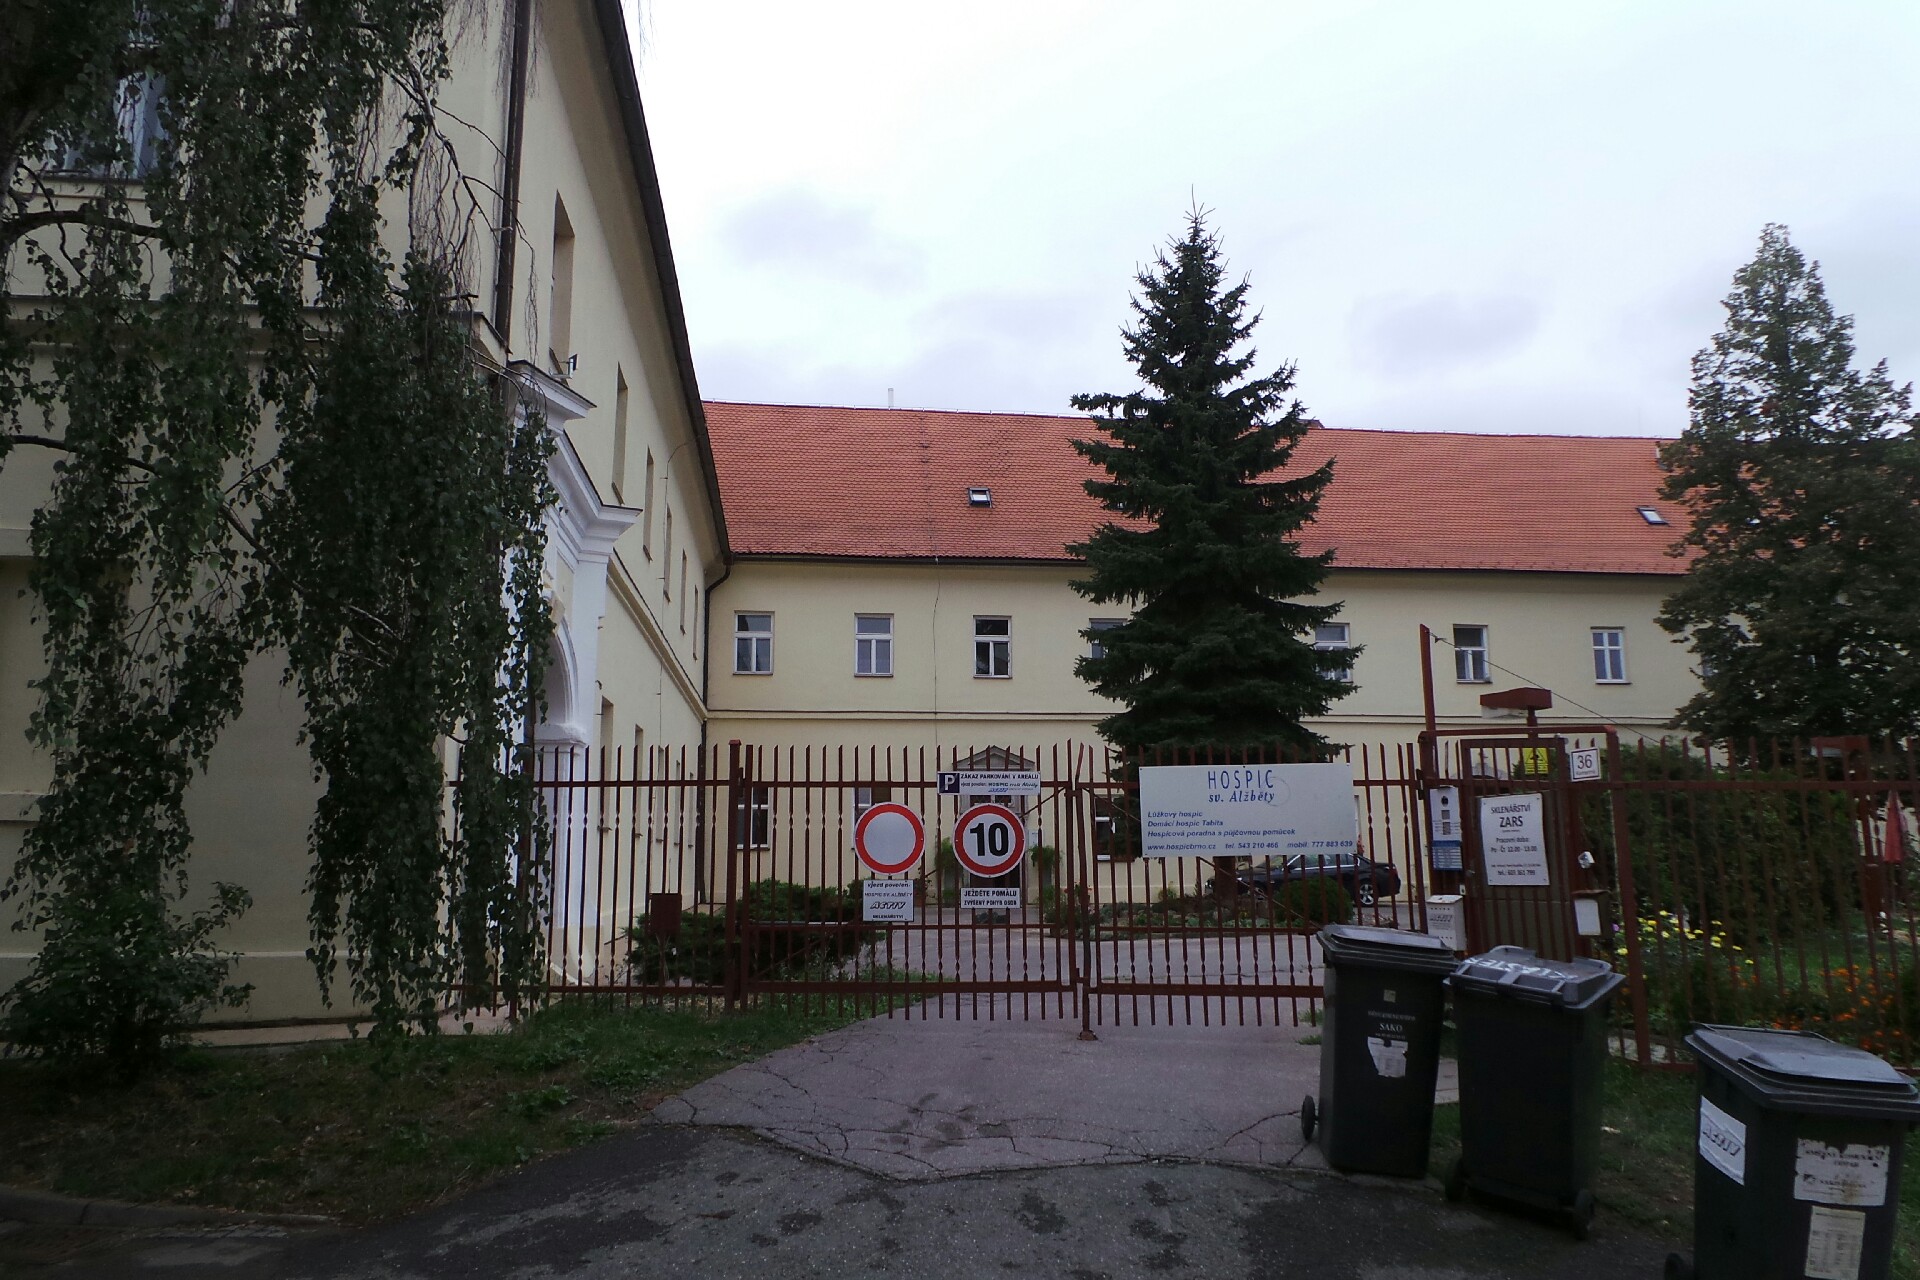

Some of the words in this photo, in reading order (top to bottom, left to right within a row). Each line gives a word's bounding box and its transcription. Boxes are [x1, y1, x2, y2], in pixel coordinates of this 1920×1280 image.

[1578, 755, 1592, 769] 36
[944, 774, 955, 790] P
[1208, 770, 1274, 790] HOSPIC
[1209, 794, 1224, 802] sv.
[1229, 790, 1274, 803] Alžběty
[1176, 820, 1200, 828] hospic
[1500, 816, 1523, 827] ZARS
[970, 823, 1008, 856] 10
[1380, 1024, 1403, 1032] SAKO
